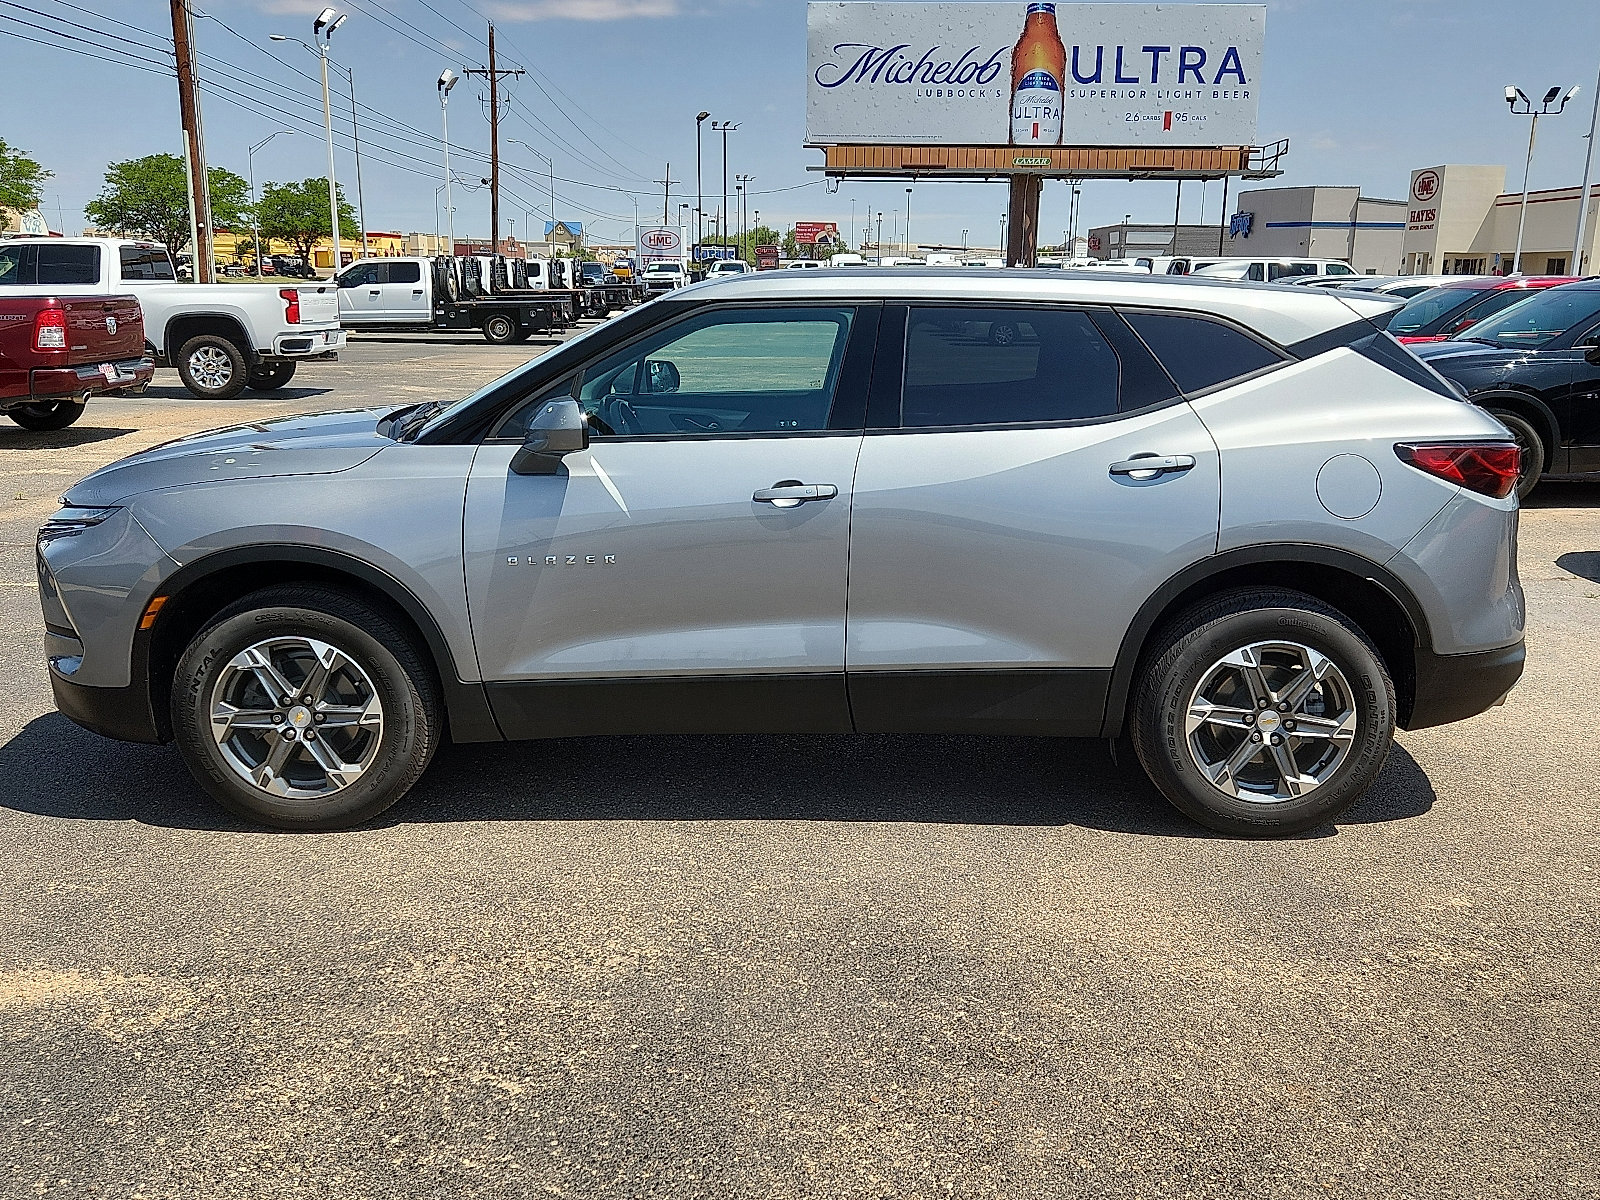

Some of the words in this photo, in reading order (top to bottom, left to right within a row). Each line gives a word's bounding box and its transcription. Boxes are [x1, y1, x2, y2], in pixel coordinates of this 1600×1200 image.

[815, 43, 1011, 88] Michelob
[1071, 45, 1247, 85] ULTRA
[917, 88, 1002, 98] LUBBOCK'S
[1070, 89, 1147, 99] SUPERIOR
[1157, 90, 1202, 99] LIGHT
[1212, 90, 1251, 99] BEER
[1020, 95, 1054, 105] Michelob
[1014, 106, 1060, 120] ULTRA
[1125, 112, 1140, 122] 2.6
[1174, 112, 1188, 122] 95
[1417, 176, 1435, 196] HMC
[1410, 209, 1436, 223] HAYES
[648, 234, 672, 247] HMC
[507, 554, 616, 566] BLAZER
[1278, 616, 1323, 633] Continental
